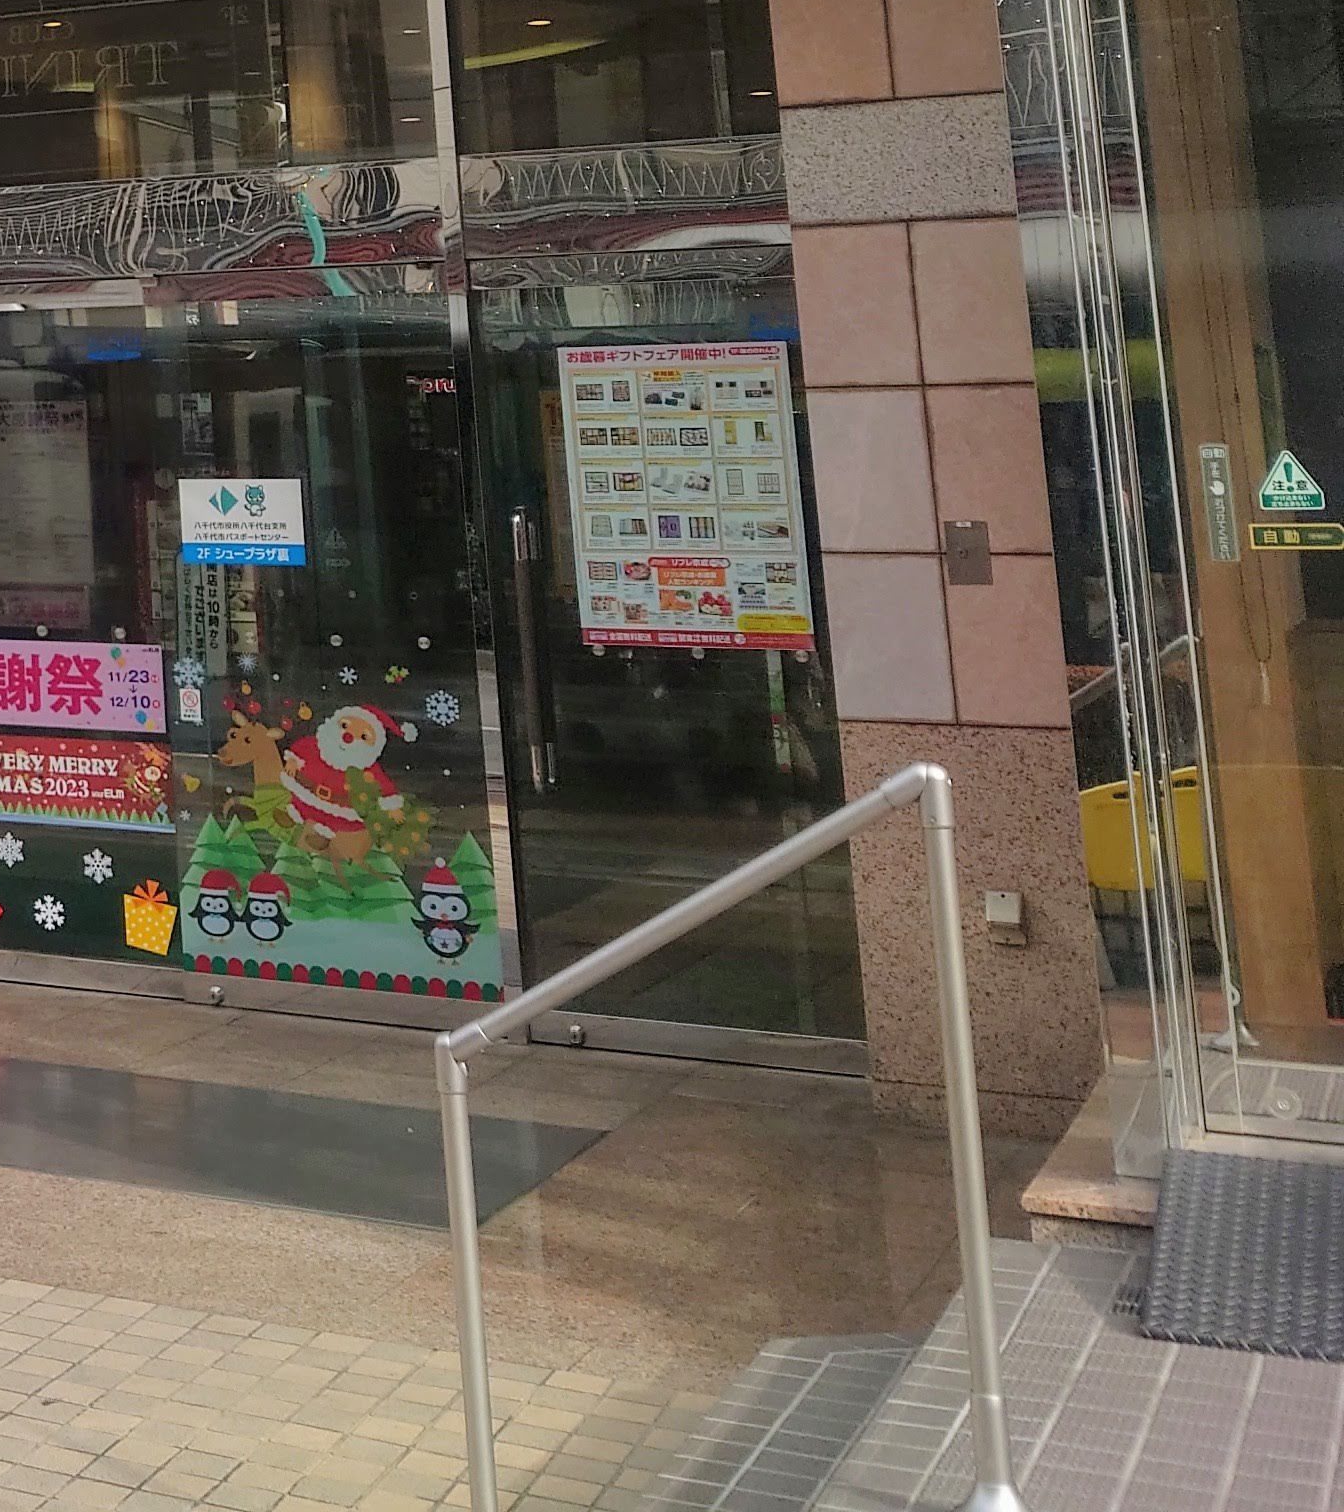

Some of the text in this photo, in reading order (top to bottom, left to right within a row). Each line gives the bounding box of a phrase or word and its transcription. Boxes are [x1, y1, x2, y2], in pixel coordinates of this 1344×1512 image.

[197, 547, 211, 560] 2F
[109, 670, 150, 683] 11/23
[110, 695, 151, 709] 12/10
[49, 755, 119, 777] MERRY
